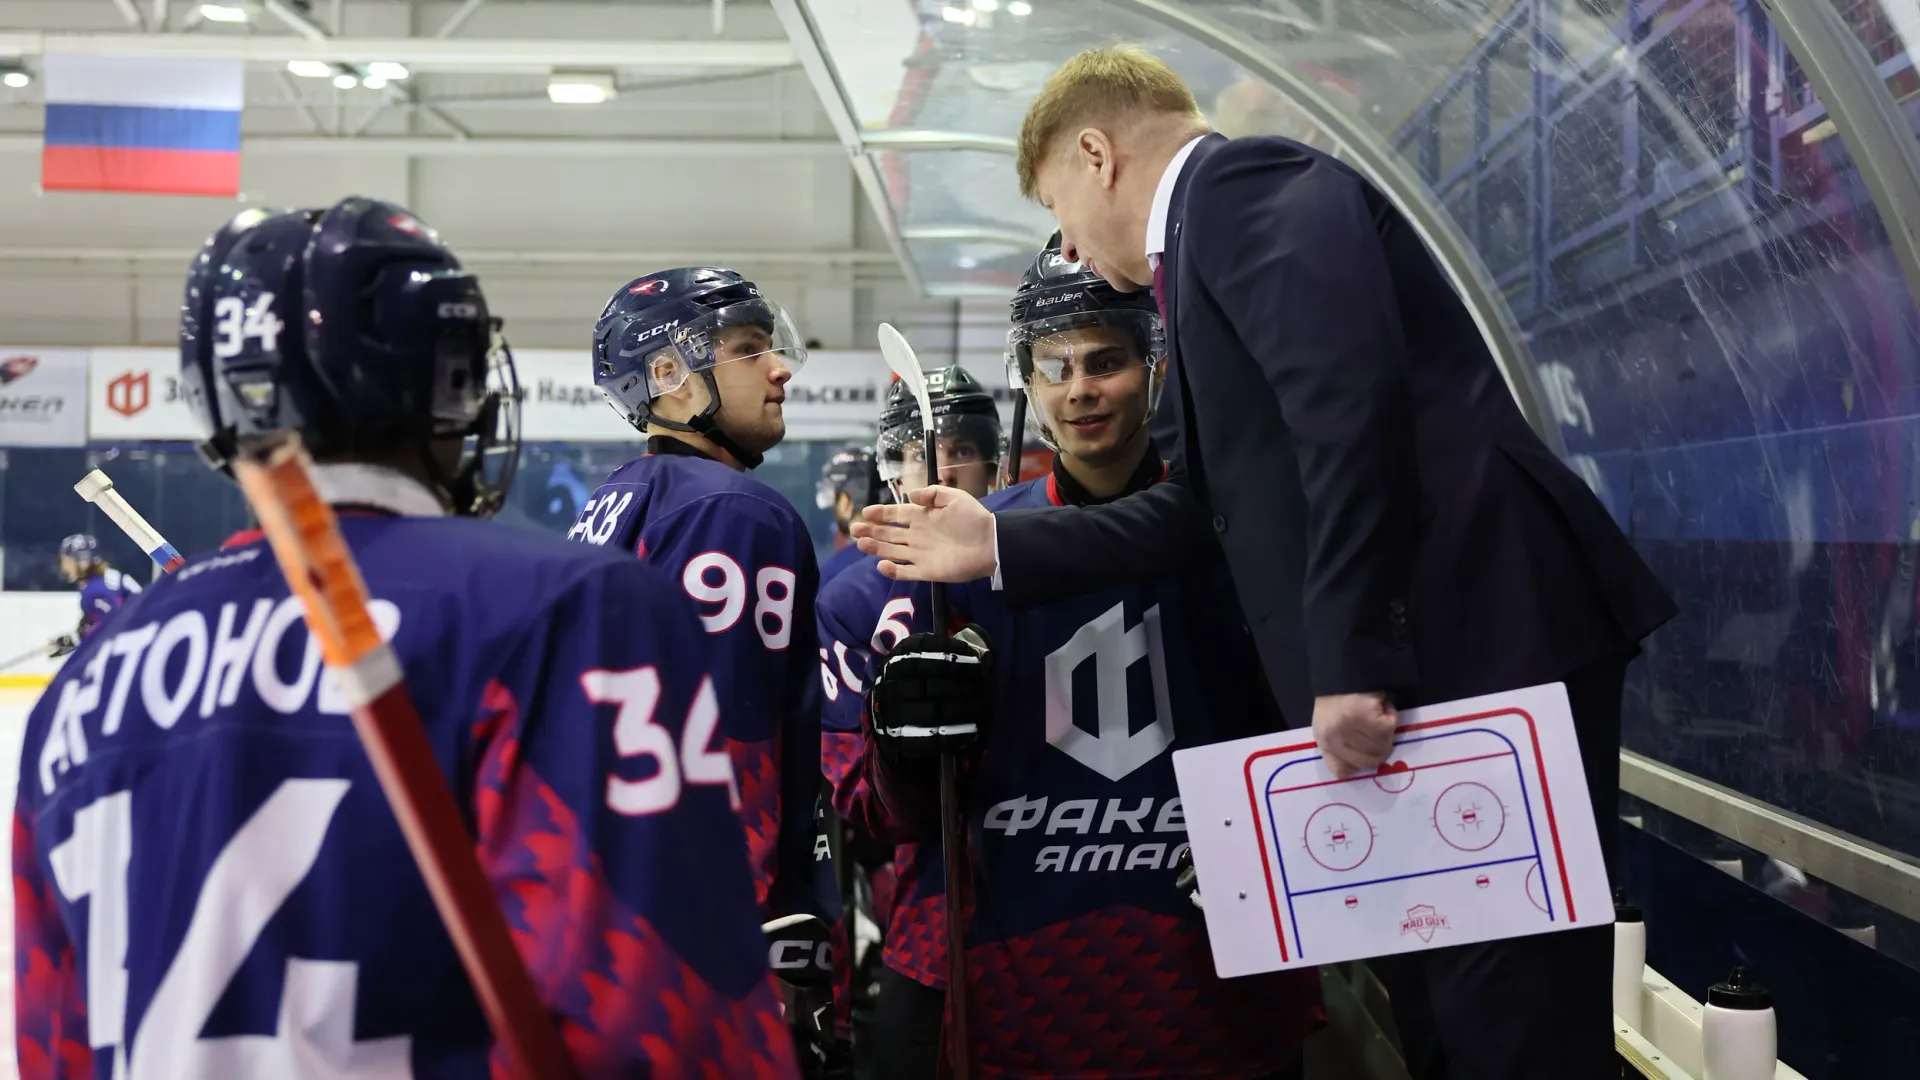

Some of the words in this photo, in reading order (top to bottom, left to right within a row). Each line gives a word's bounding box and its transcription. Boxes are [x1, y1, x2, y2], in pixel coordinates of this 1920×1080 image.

[213, 292, 276, 357] 34
[636, 318, 680, 343] CCM
[682, 550, 796, 650] 98
[579, 665, 742, 817] 34
[1425, 917, 1446, 927] GUY
